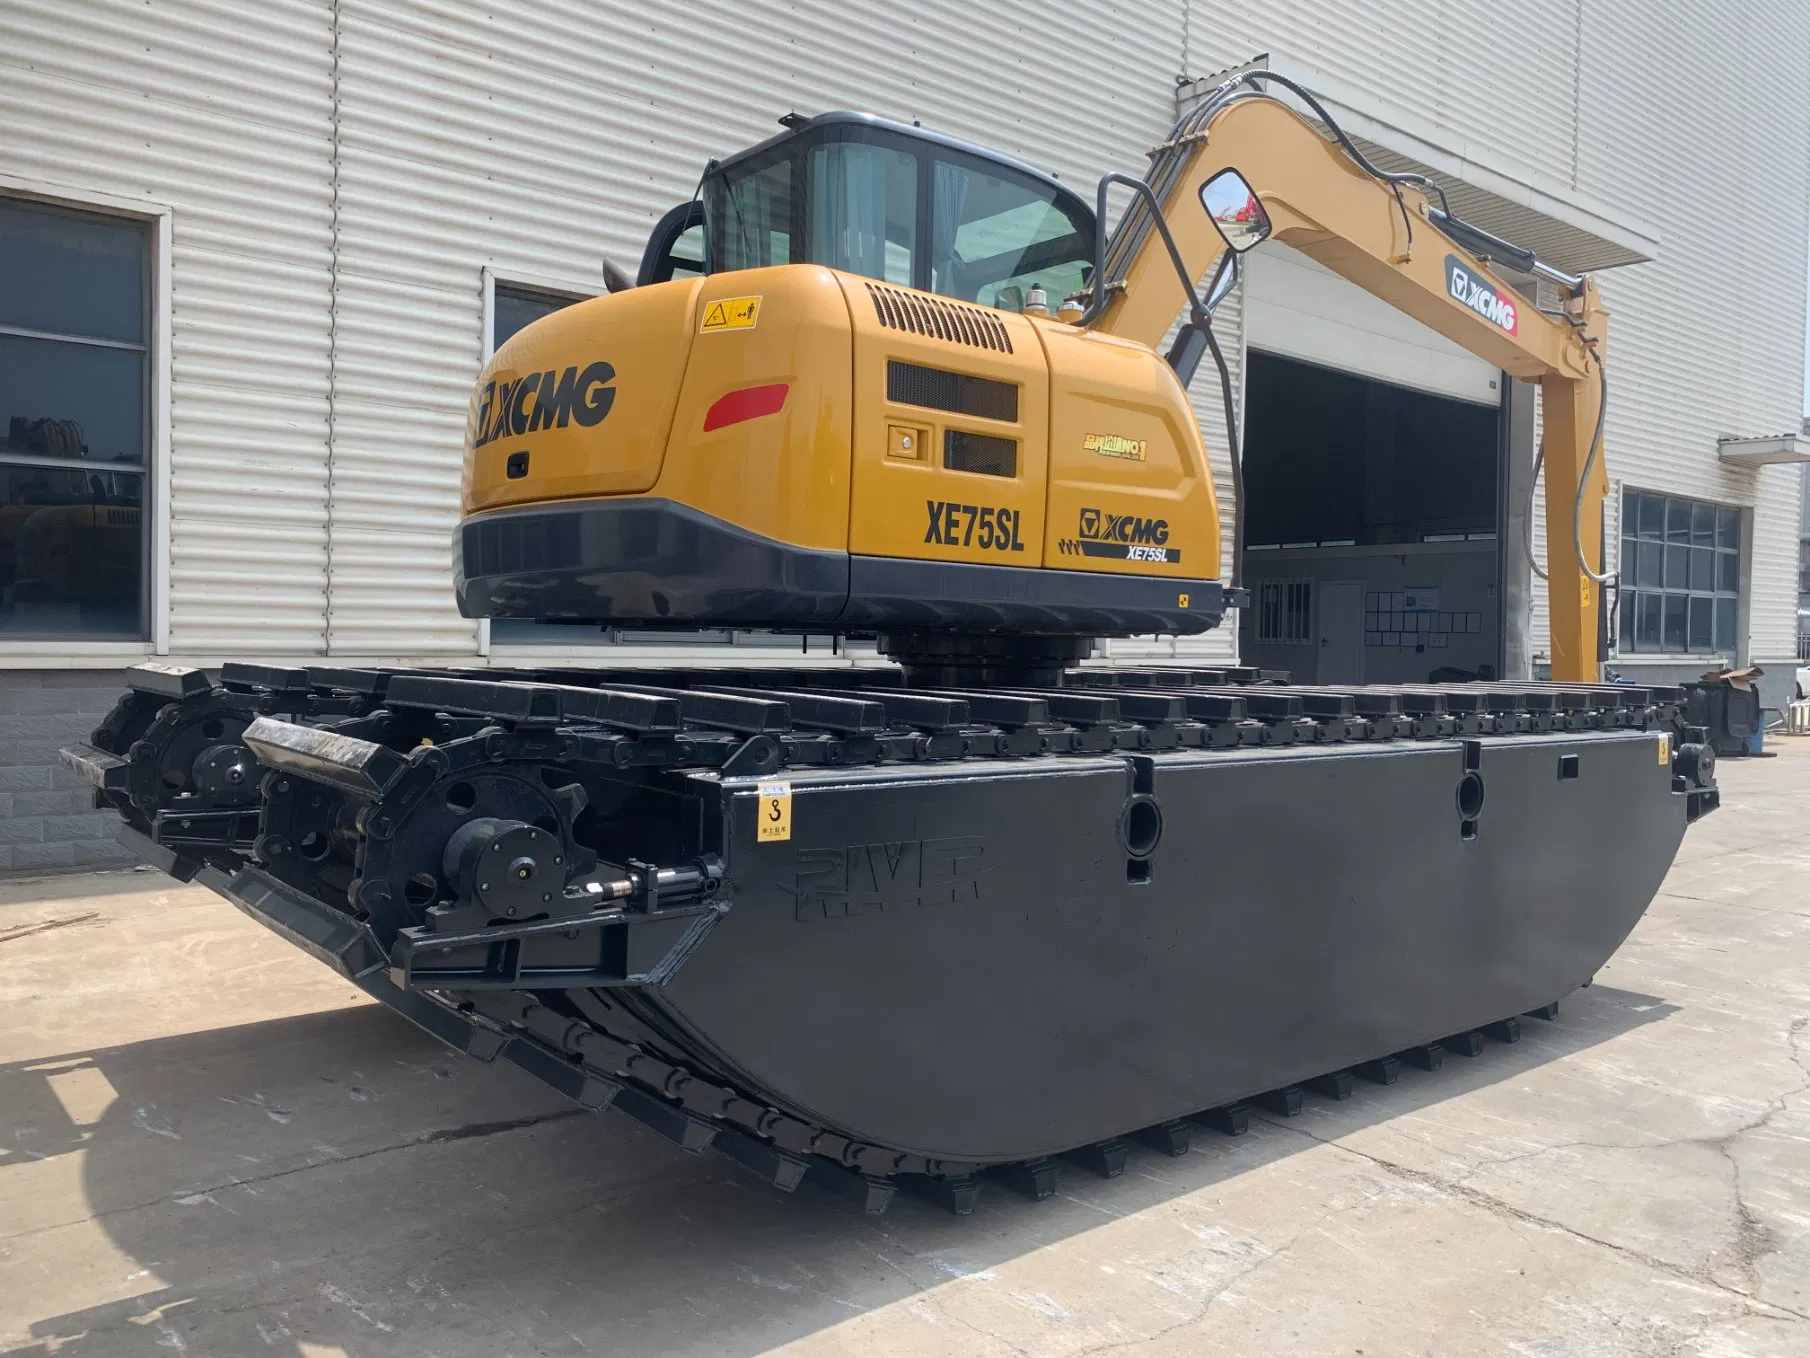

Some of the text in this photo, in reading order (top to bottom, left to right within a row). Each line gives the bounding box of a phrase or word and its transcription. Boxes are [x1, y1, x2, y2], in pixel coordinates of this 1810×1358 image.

[1465, 281, 1515, 331] XCMG
[490, 361, 617, 443] XCMG
[924, 500, 1025, 551] XE75SL
[1099, 514, 1169, 545] XCMG
[1126, 546, 1168, 562] XE75SL
